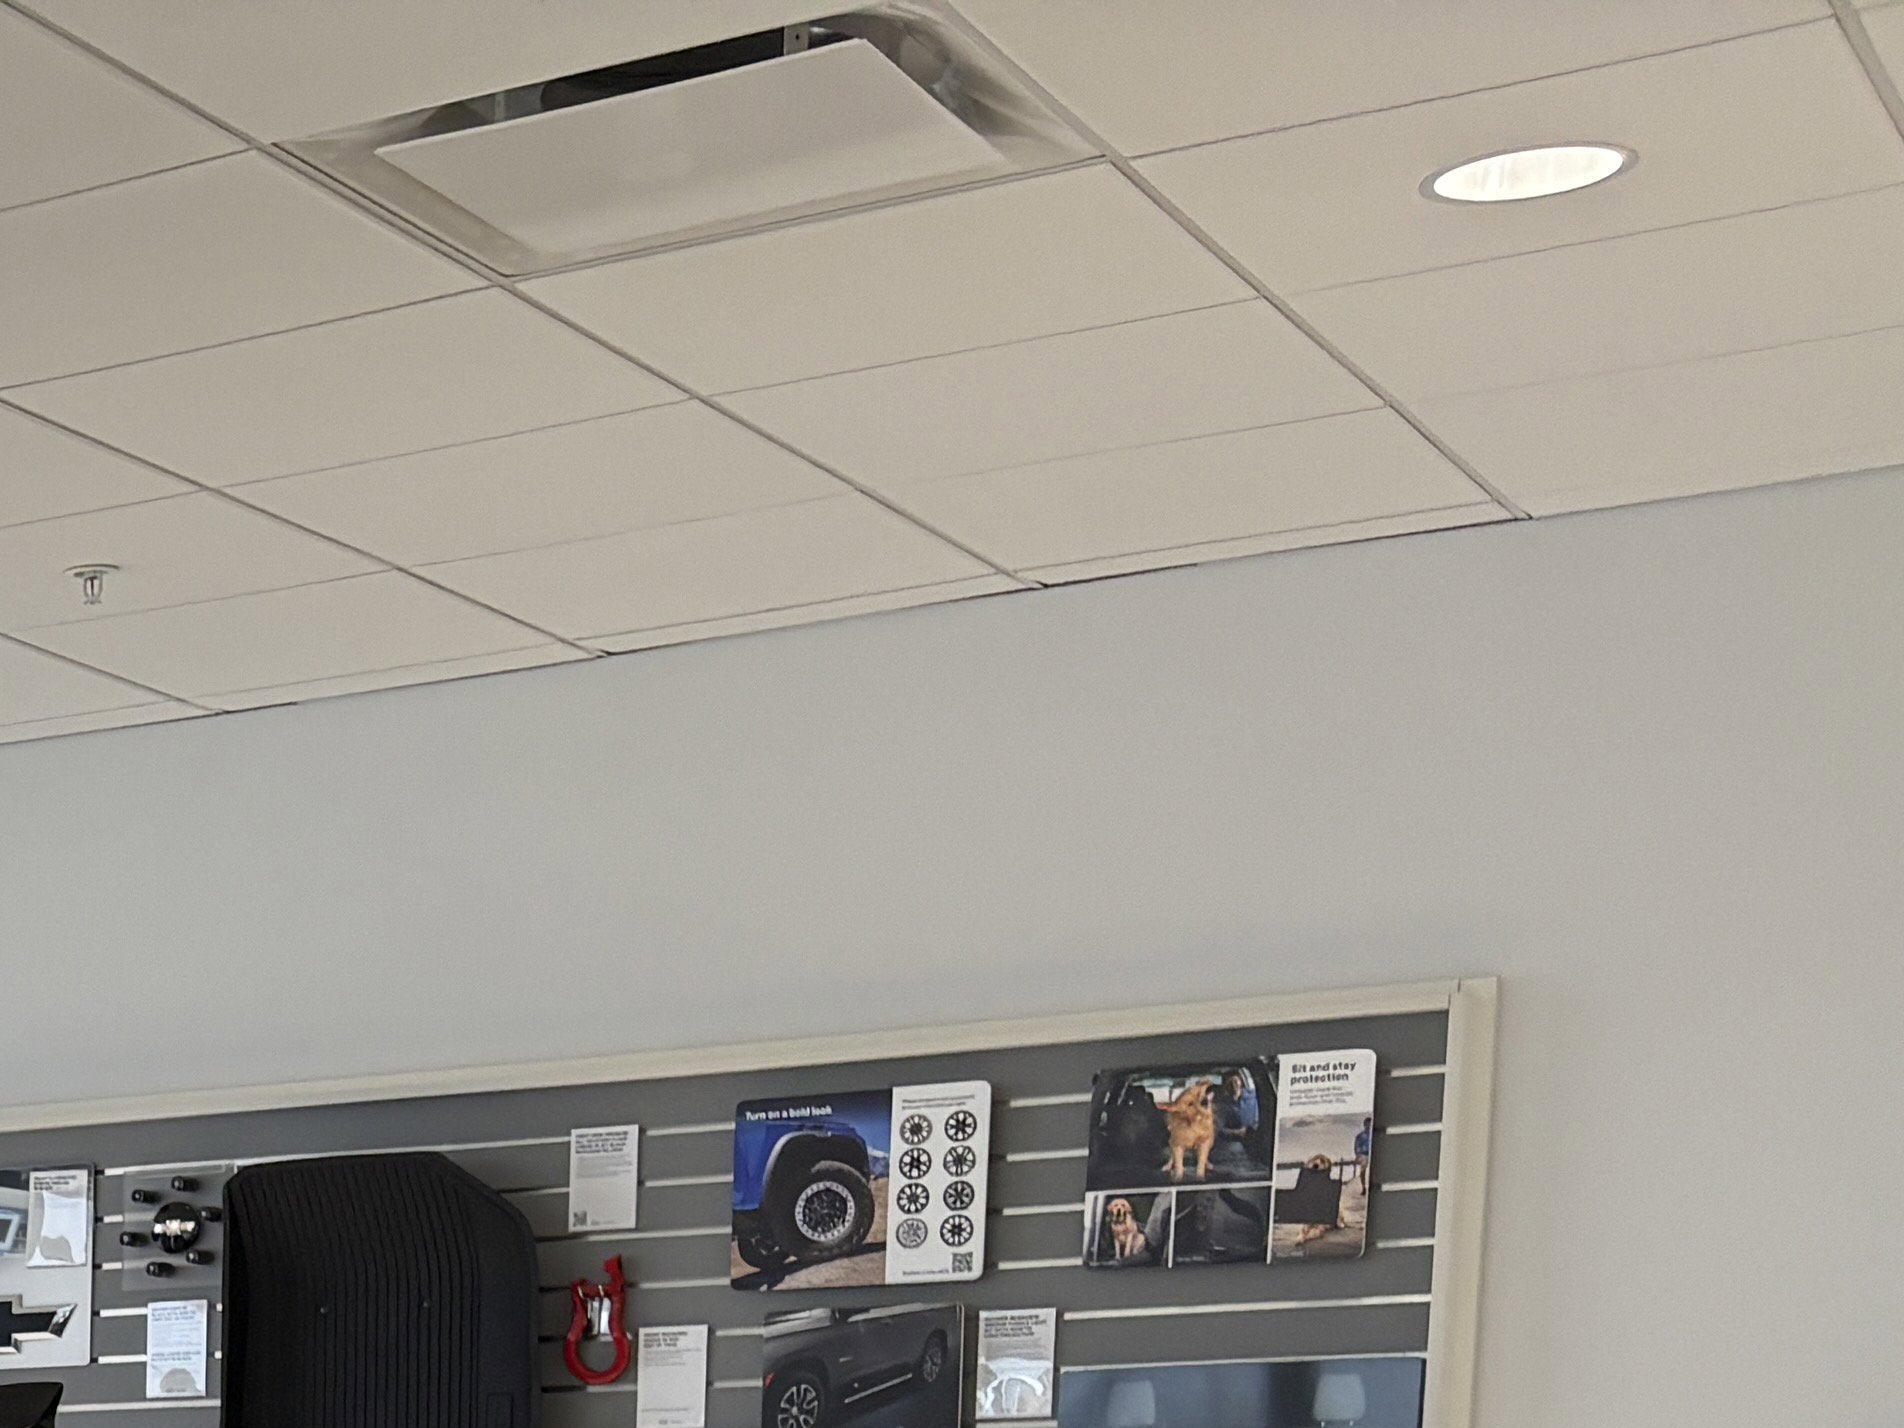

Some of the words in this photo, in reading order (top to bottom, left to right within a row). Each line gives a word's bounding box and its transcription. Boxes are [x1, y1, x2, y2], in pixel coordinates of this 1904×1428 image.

[1309, 1062, 1330, 1073] and
[1332, 1061, 1357, 1072] stay
[1290, 1073, 1349, 1086] protection
[745, 1111, 767, 1121] Turn
[781, 1109, 788, 1118] a
